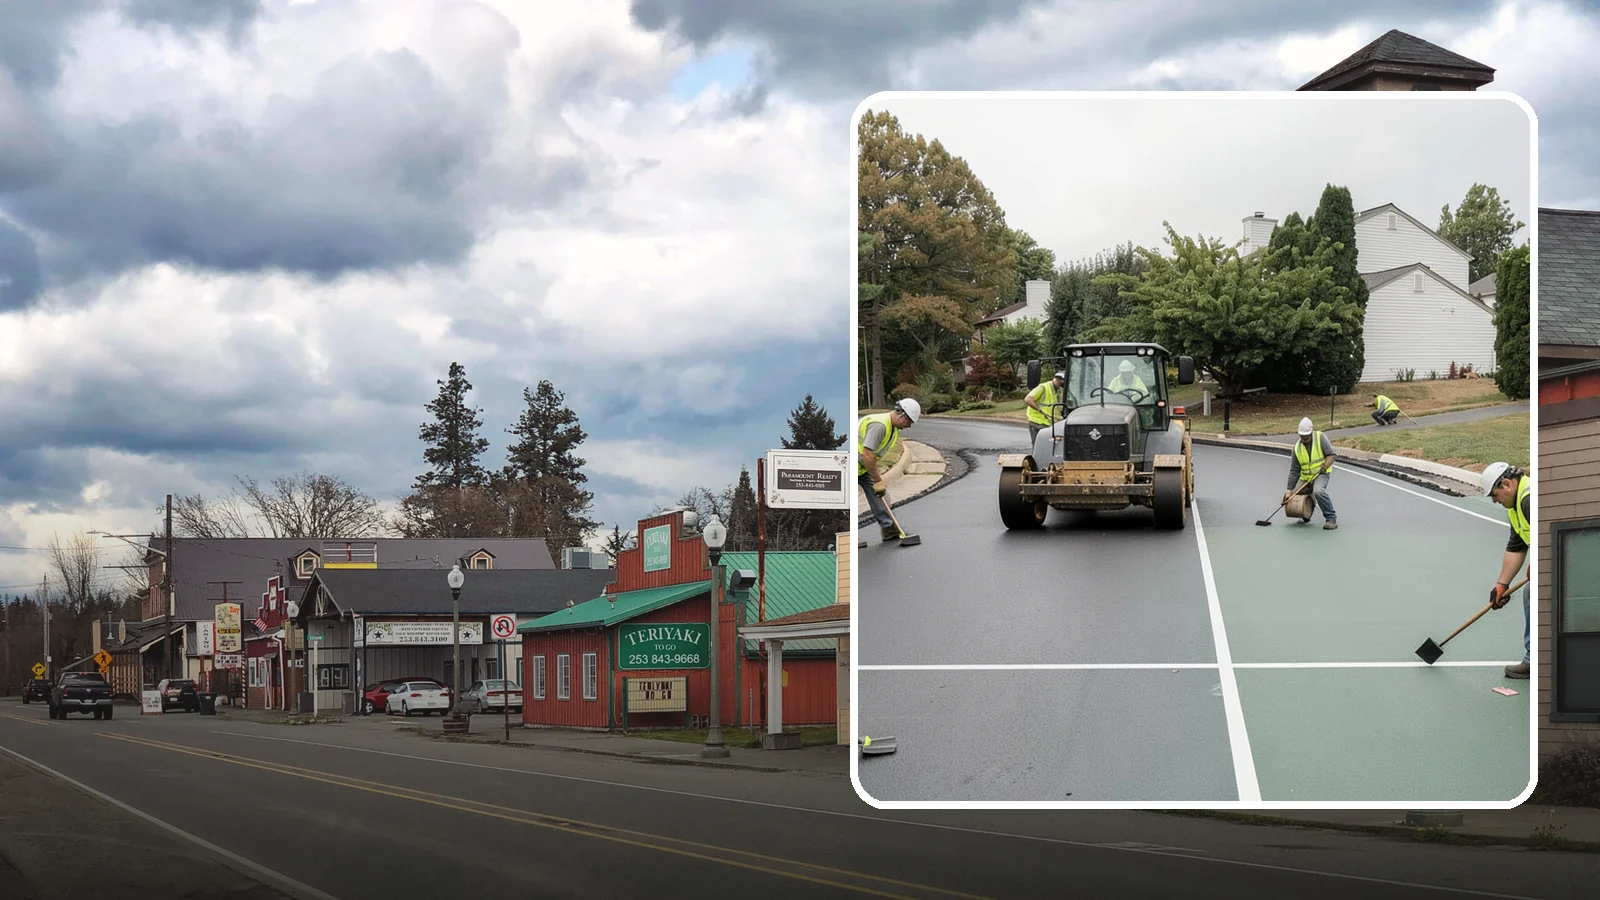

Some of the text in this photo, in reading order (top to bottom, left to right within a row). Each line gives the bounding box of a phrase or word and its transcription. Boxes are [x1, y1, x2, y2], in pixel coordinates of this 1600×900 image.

[625, 628, 702, 646] TERIYAKI
[629, 654, 700, 664] 253 843-9668
[639, 681, 672, 690] TERIYAKI
